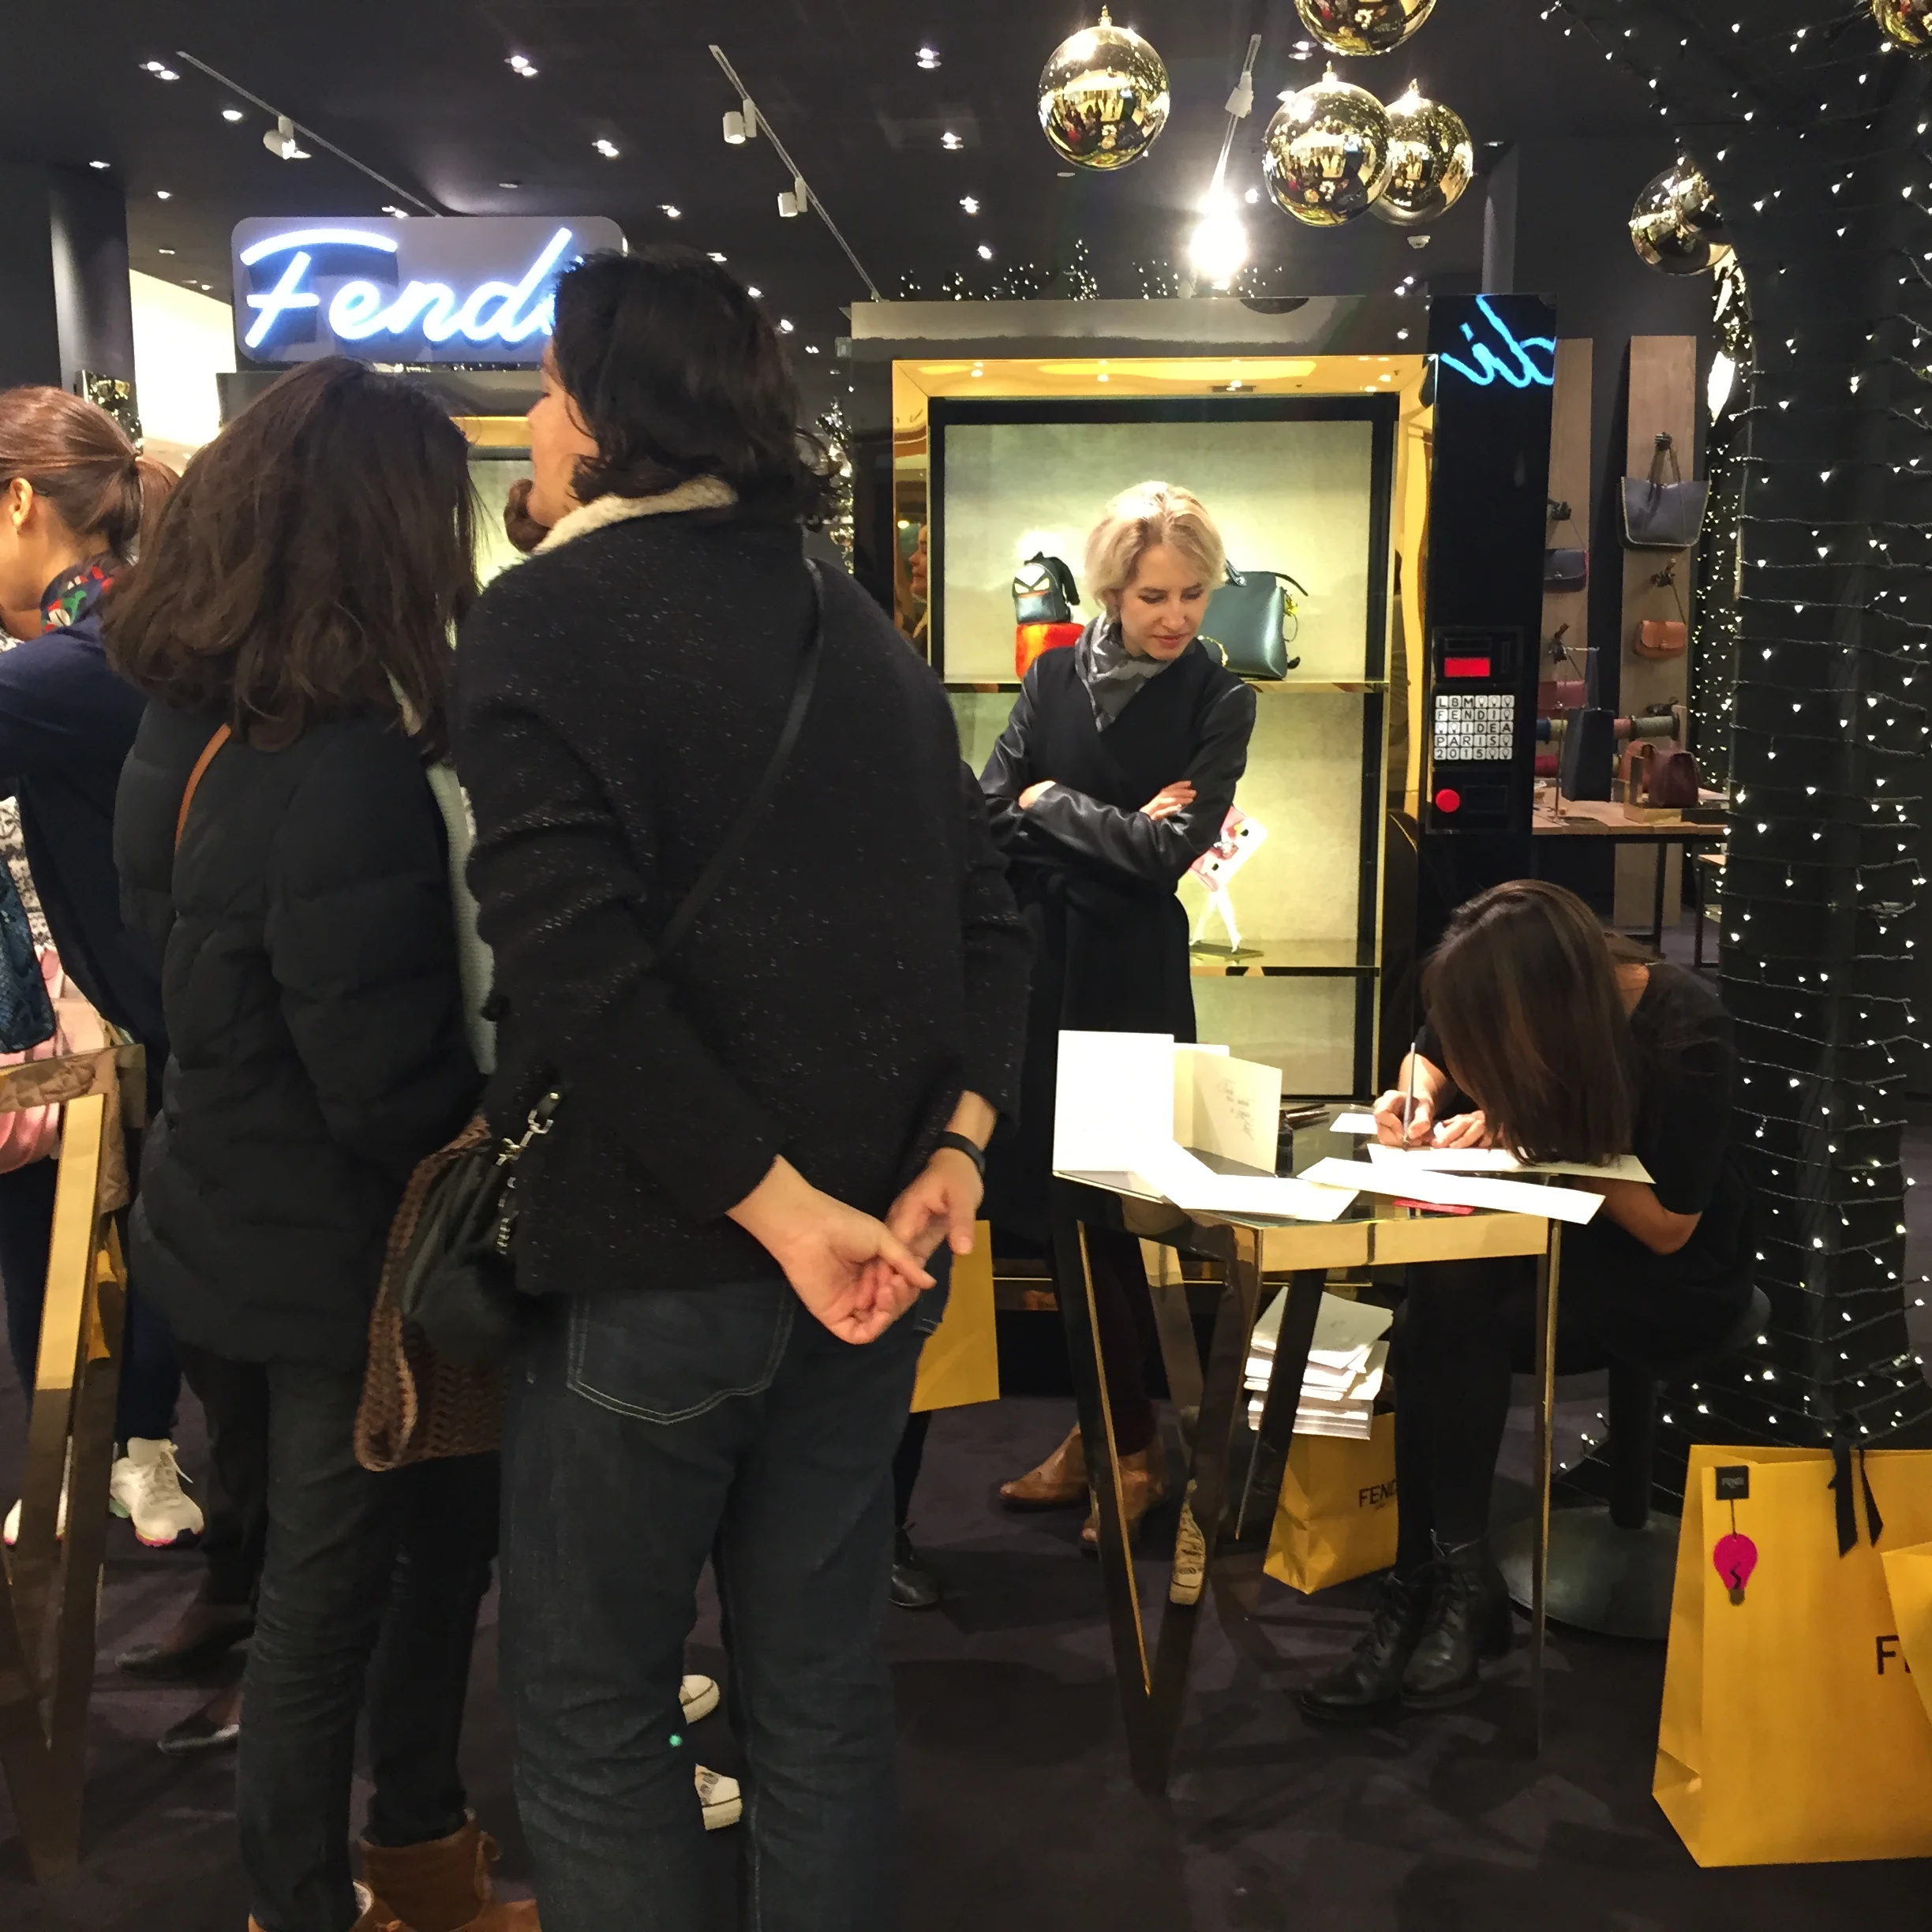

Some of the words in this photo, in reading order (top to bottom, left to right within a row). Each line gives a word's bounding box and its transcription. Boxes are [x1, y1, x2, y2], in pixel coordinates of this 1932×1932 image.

[240, 226, 583, 348] Fend
[1438, 710, 1496, 720] FENDI
[1466, 723, 1511, 733] IDEA
[1436, 736, 1497, 747] PARIS
[1436, 749, 1484, 758] 2015
